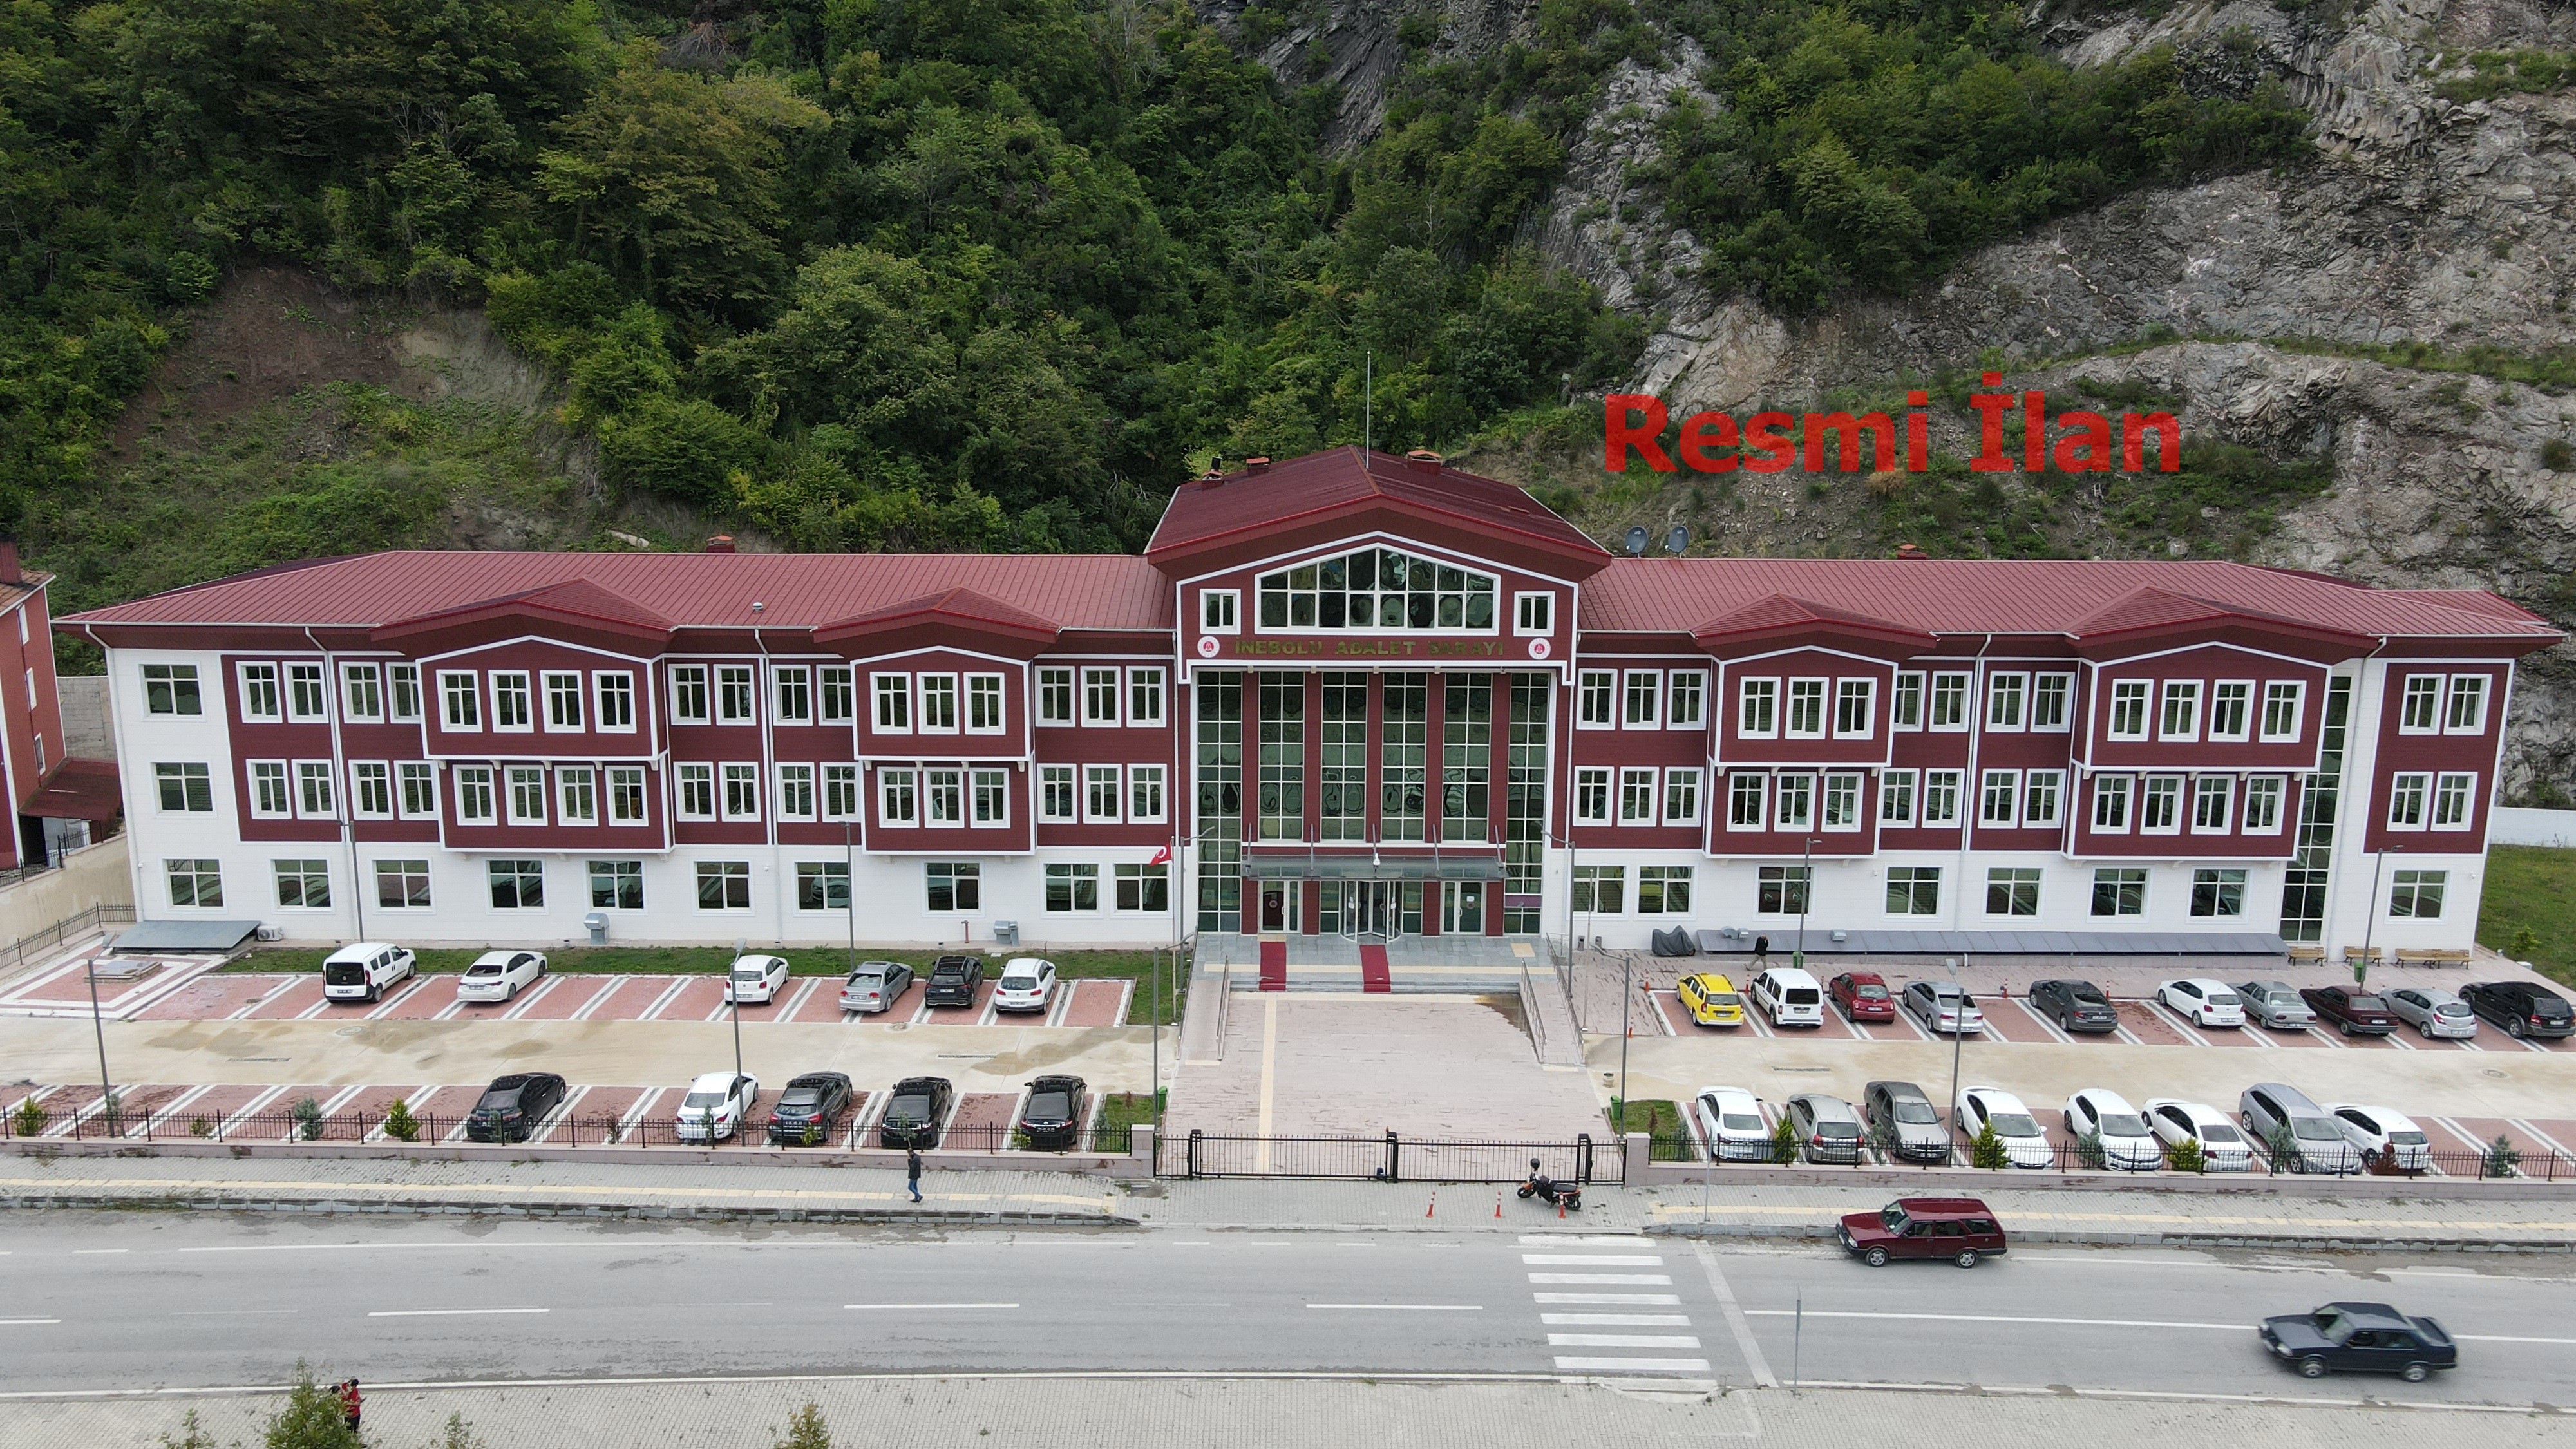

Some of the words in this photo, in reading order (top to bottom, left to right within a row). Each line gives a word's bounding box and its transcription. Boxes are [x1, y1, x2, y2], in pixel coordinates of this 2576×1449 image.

[1235, 637, 1323, 654] İNEBOLU
[1335, 641, 1416, 655] ADALET
[1428, 641, 1504, 656] SARAYI
